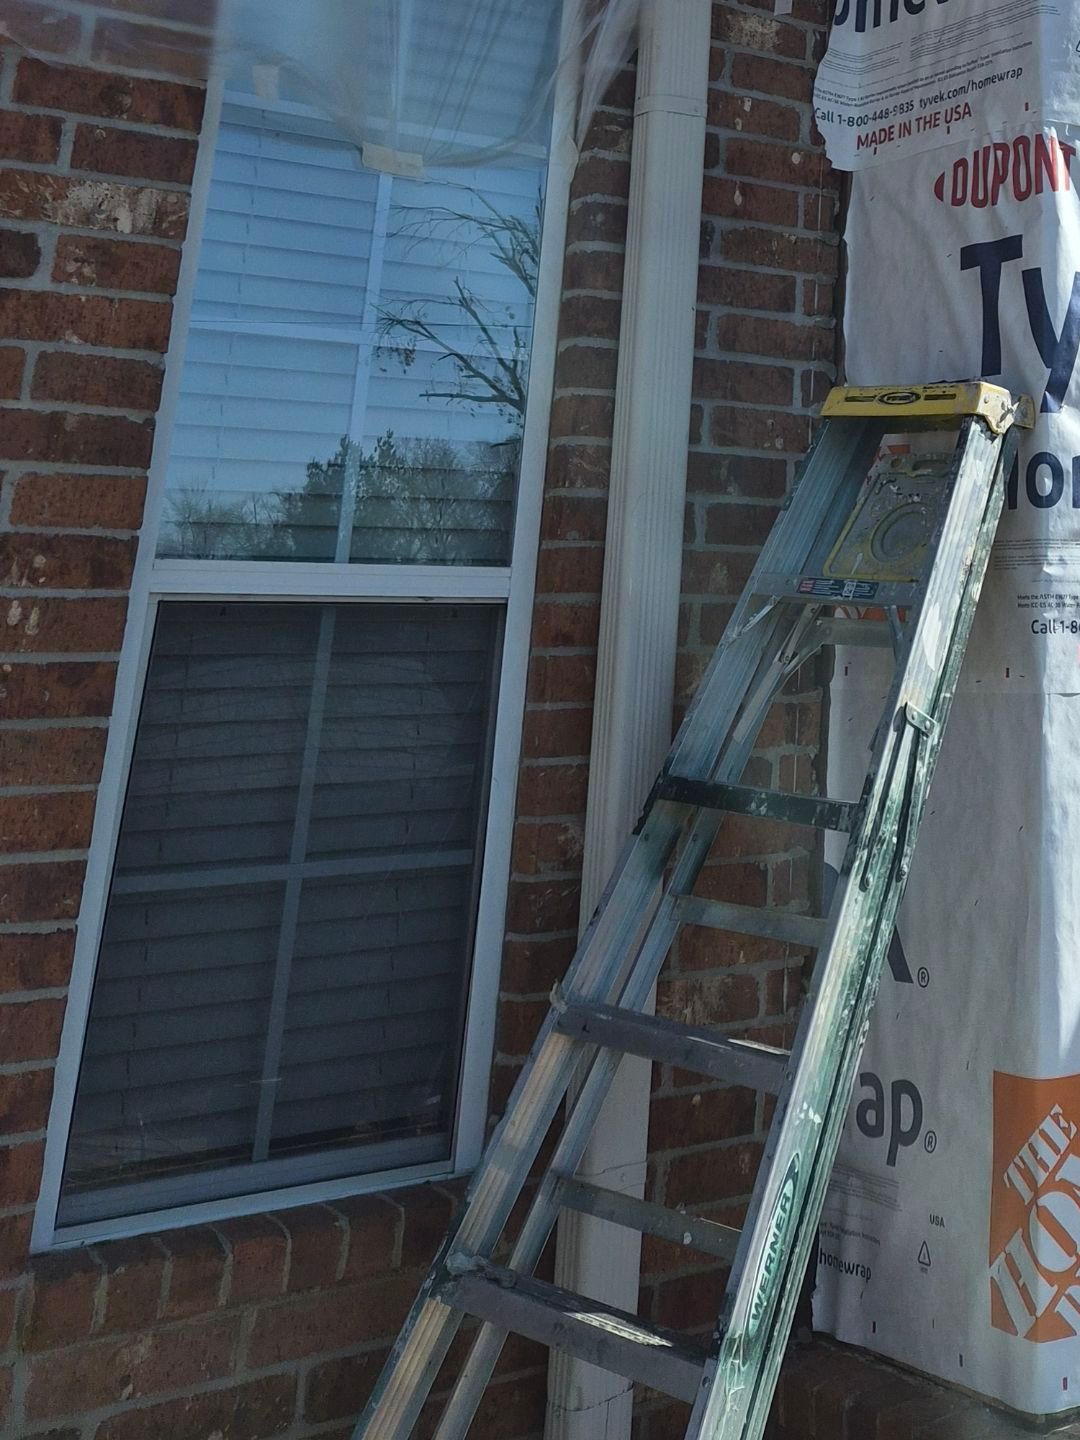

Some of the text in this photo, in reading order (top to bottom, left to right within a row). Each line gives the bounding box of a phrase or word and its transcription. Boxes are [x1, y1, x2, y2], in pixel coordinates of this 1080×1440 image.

[814, 107, 834, 124] Call
[837, 100, 915, 128] 1-800-448-9835
[919, 67, 1024, 110] tyvek.com/homewrap
[856, 101, 973, 151] MADE IN THE USA
[951, 133, 1076, 209] DUPONT
[1031, 619, 1057, 634] Call
[1003, 1103, 1078, 1206] THE
[929, 1213, 945, 1229] USA
[750, 1189, 793, 1324] WERNER
